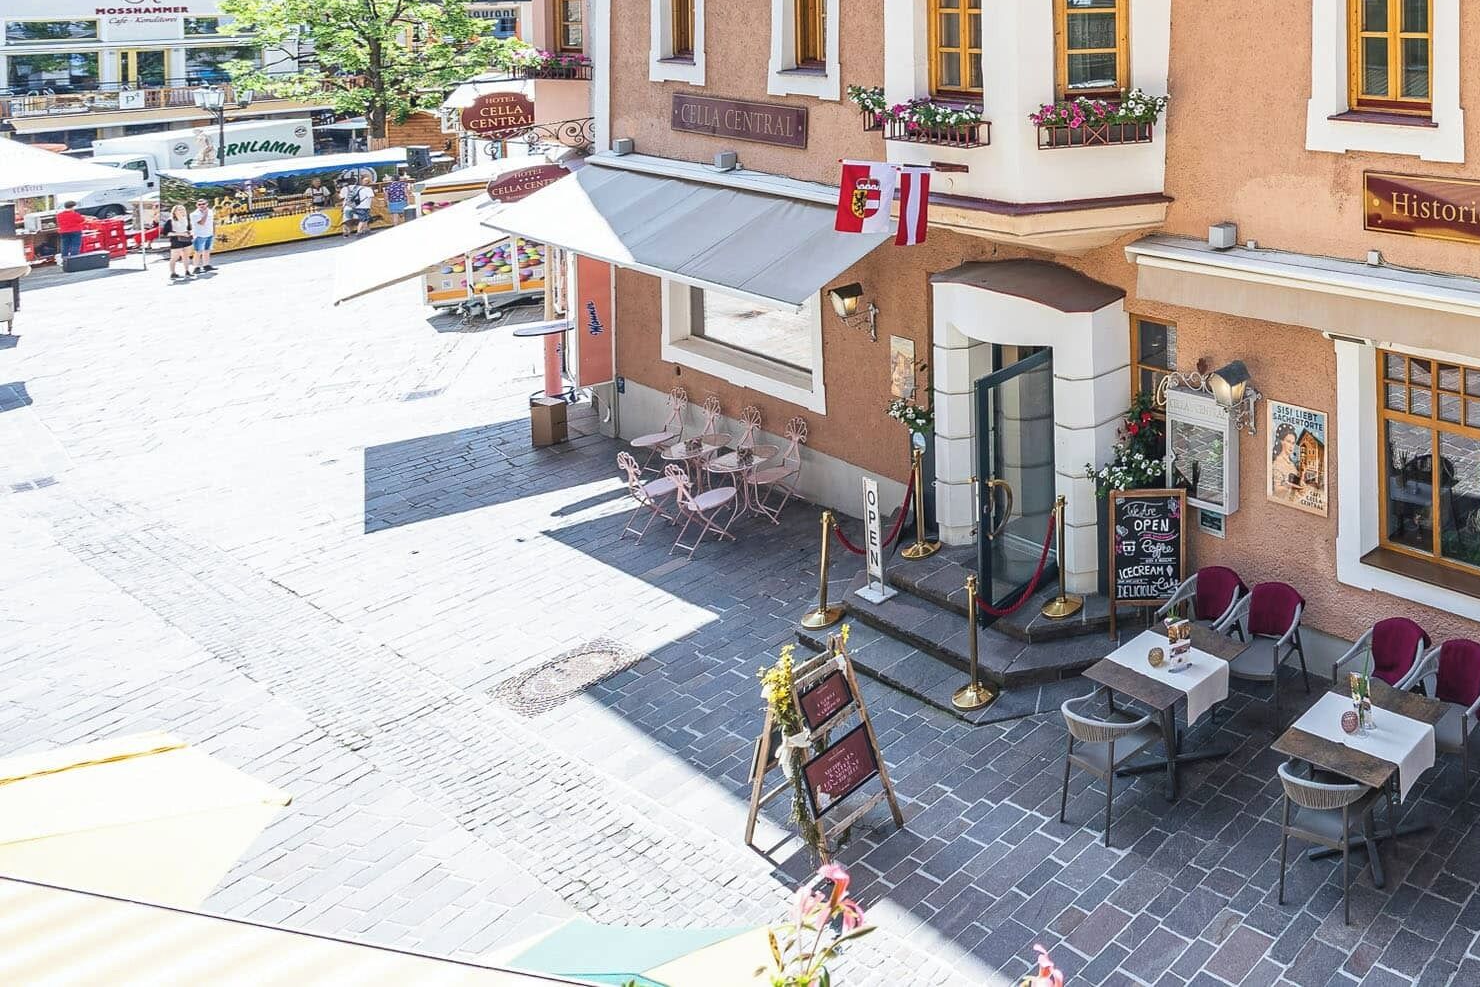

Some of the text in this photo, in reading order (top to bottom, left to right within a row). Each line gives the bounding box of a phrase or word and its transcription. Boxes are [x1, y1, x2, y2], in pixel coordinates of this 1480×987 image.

[95, 6, 189, 15] MOSSHAMMER
[485, 95, 517, 104] HOTEL
[480, 105, 524, 117] CELLA
[680, 103, 794, 137] CELLA CENTRAL
[514, 168, 544, 179] HOTEL
[491, 185, 522, 196] CELLA
[1276, 405, 1318, 423] SISI LIEBT
[1272, 412, 1324, 432] SACHERTORTE
[867, 490, 879, 567] OPEN
[1134, 518, 1169, 532] OPEN
[1141, 539, 1174, 559] Coffee
[1118, 565, 1164, 580] ICECREAM
[1117, 584, 1159, 599] DELICIOUS
